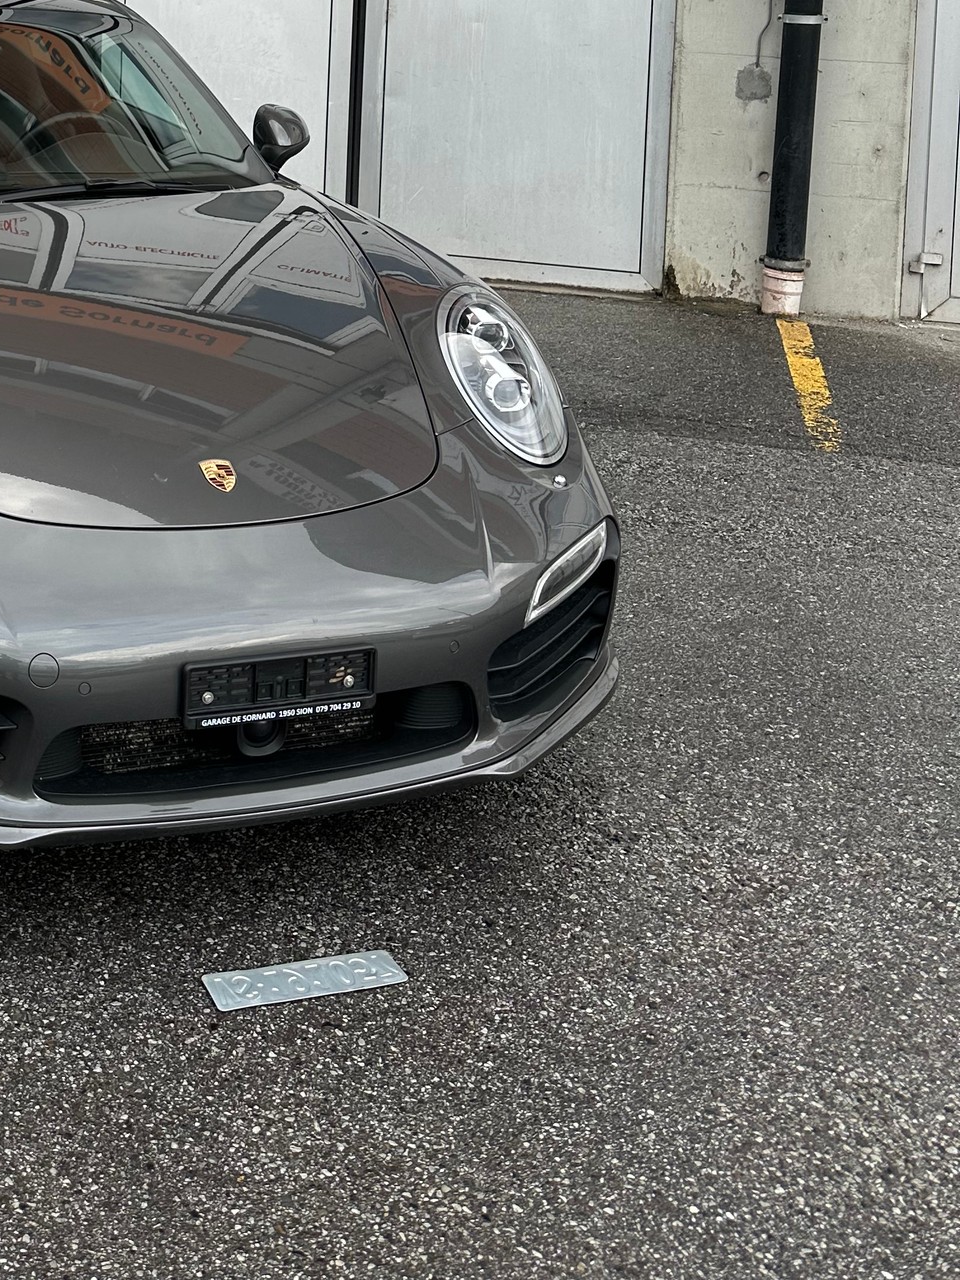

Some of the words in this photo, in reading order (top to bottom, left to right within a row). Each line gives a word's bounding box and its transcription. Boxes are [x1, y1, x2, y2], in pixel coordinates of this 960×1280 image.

[201, 716, 231, 727] GARAGE
[232, 714, 241, 724] DE
[242, 710, 276, 722] SORNARD
[278, 708, 296, 718] 1950
[296, 706, 313, 716] SION
[315, 704, 328, 713] 079
[329, 702, 342, 712] 704
[342, 702, 351, 710] 29
[352, 700, 361, 709] 10
